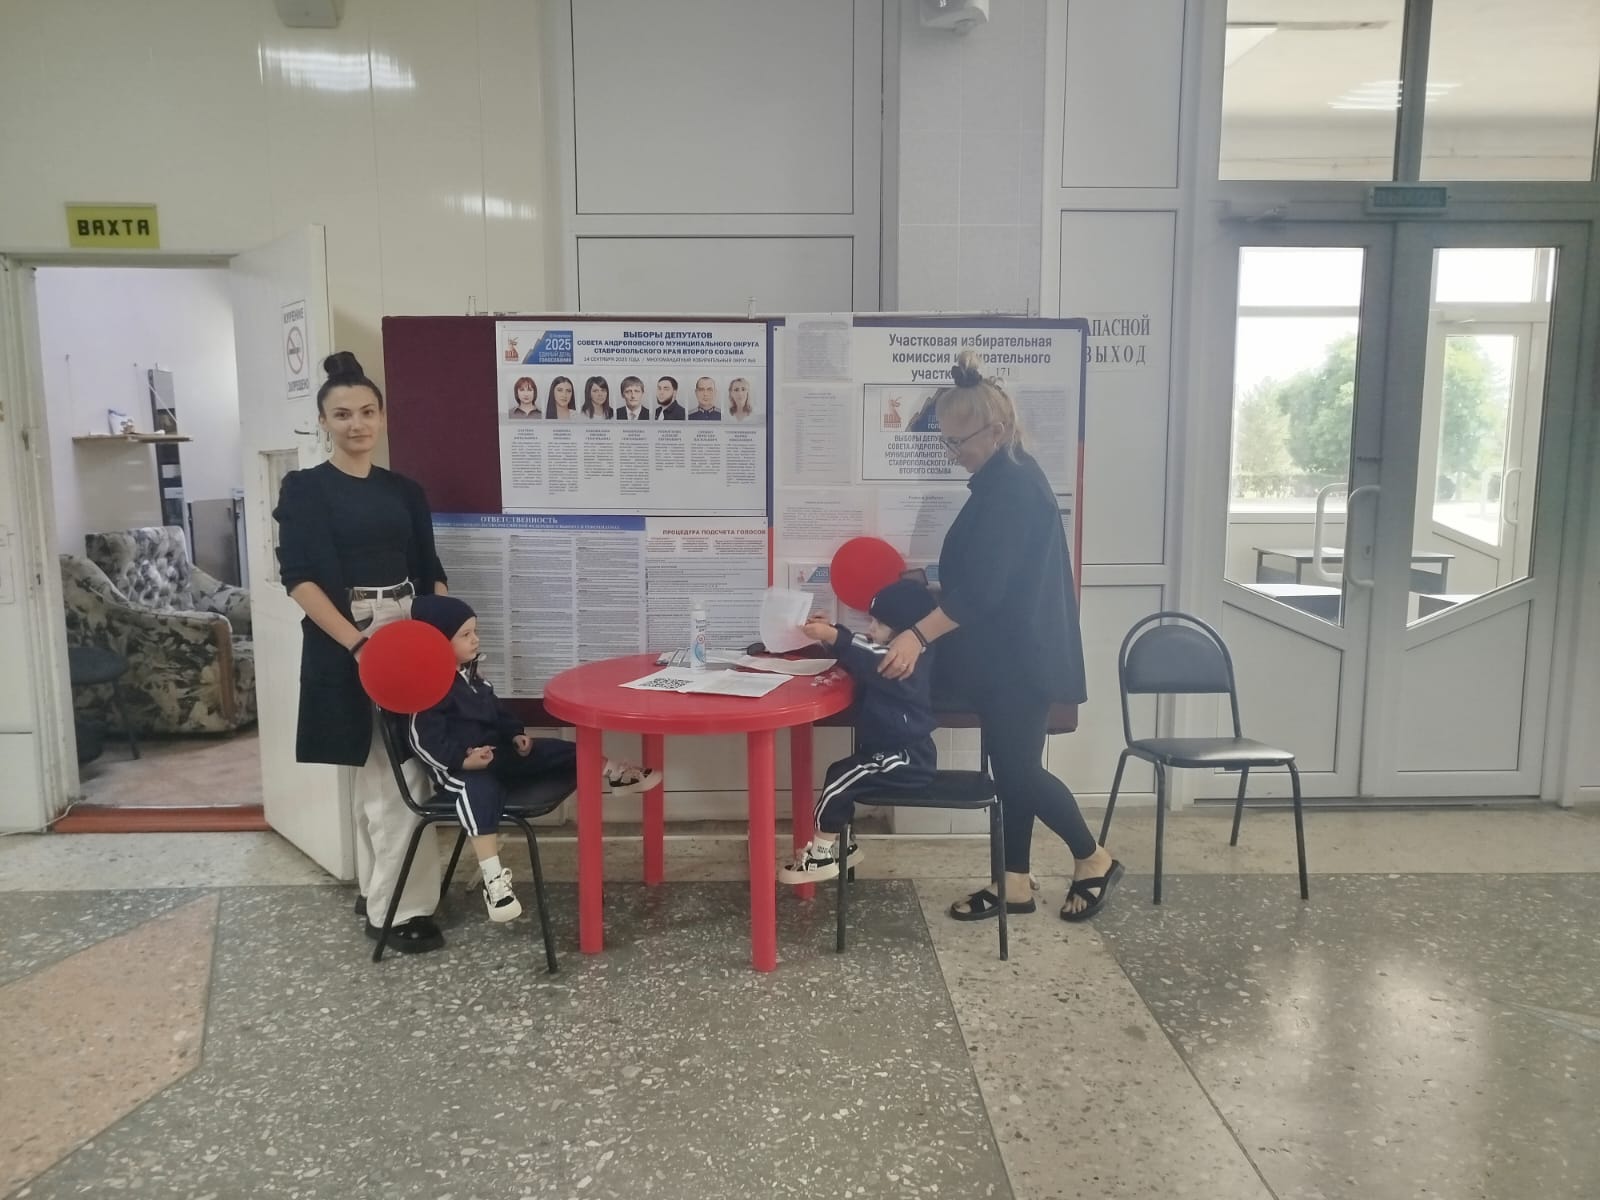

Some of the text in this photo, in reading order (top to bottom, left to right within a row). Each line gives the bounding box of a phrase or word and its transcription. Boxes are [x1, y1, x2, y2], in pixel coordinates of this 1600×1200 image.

[77, 219, 150, 236] ВАХТА
[664, 331, 713, 339] ДЕПУТАТОВ
[545, 338, 571, 351] 2025
[665, 340, 732, 348] МУНИЦИПАЛЬНОГО
[889, 333, 1052, 350] Участковая избирательная
[892, 352, 1051, 364] комиссия ирательного
[911, 369, 953, 382] участк
[894, 434, 922, 442] ВЫБОРЫ
[887, 442, 910, 450] СОВЕТА
[884, 451, 942, 459] МУНИЦИПАЛЬНОГО
[888, 459, 946, 467] СТАВРОПОЛЬСКОГО
[899, 467, 926, 475] ВТОРОГО
[480, 516, 559, 524] ОТВЕТСТВЕННОСТЬ
